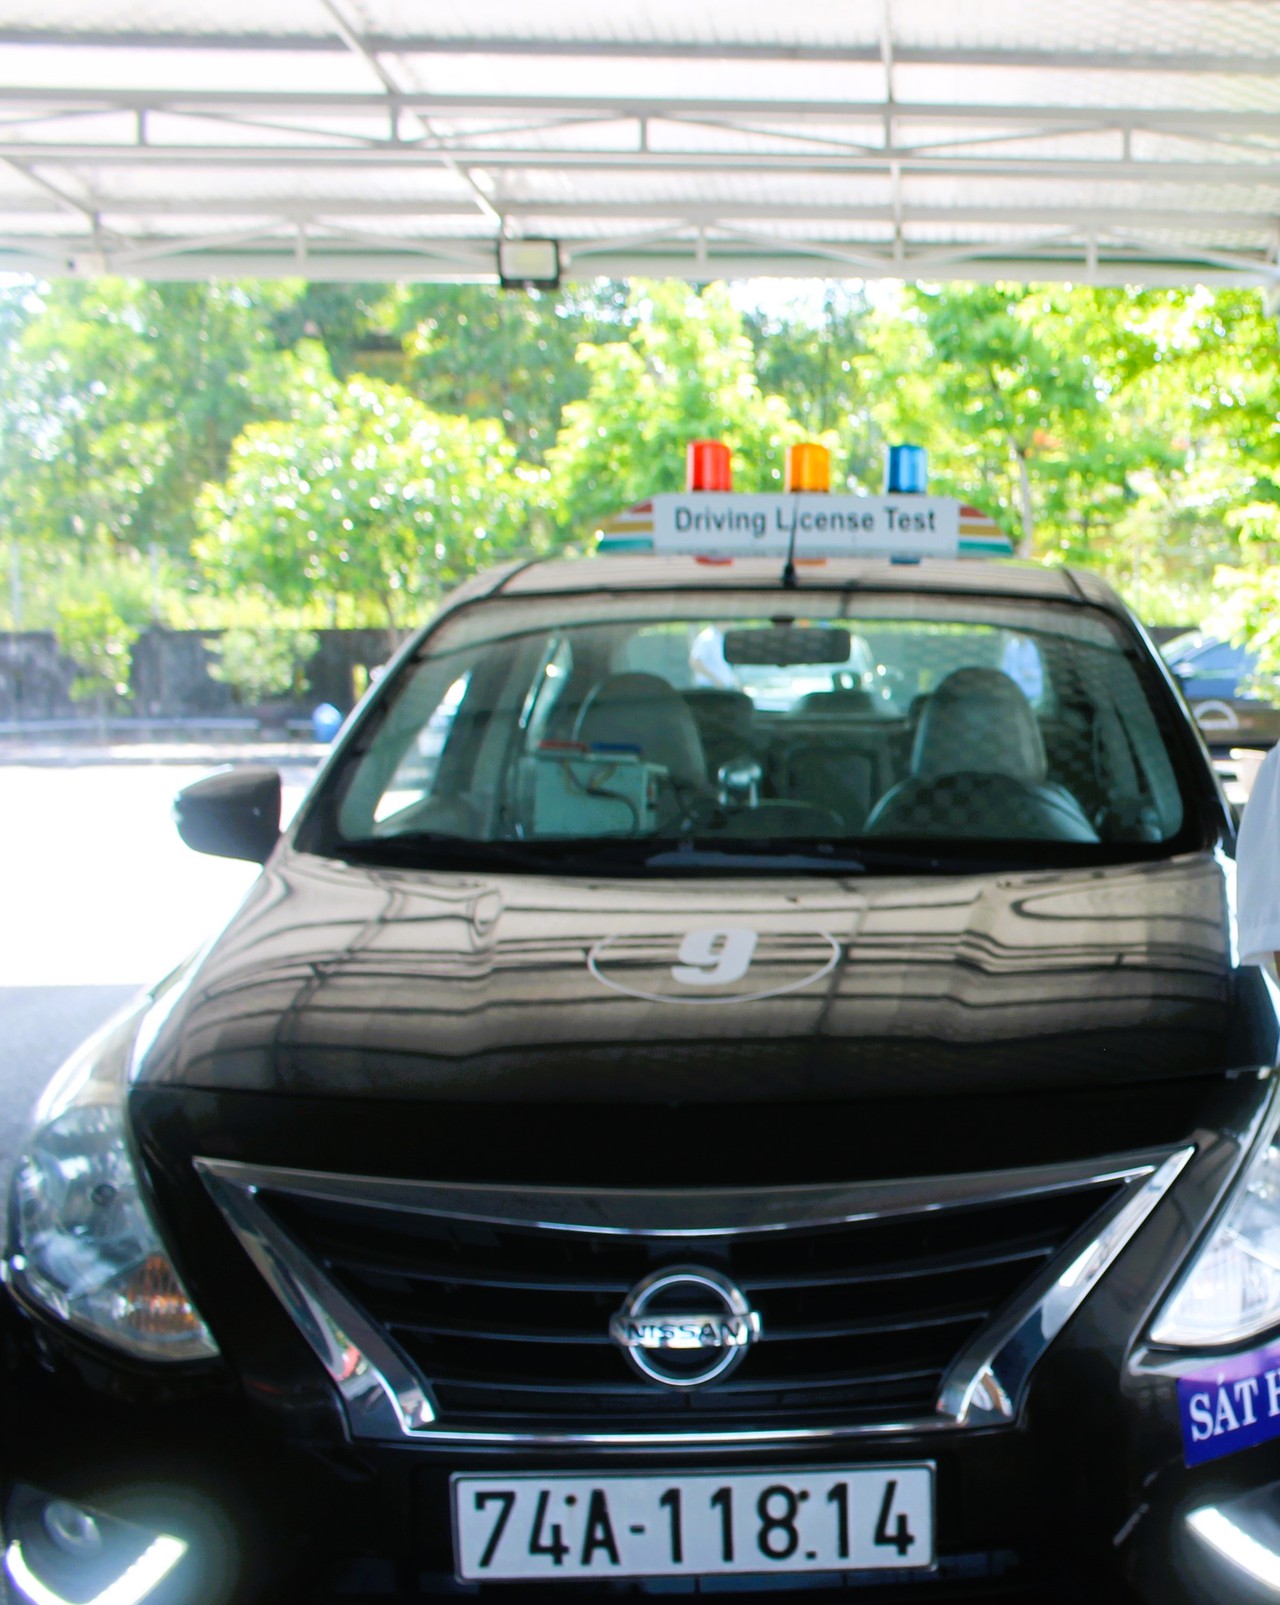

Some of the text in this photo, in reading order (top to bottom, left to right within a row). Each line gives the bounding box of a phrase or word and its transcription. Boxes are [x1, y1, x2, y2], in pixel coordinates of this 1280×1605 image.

[674, 505, 768, 538] Driving
[883, 505, 936, 531] Test
[671, 928, 758, 985] 9
[626, 1321, 749, 1348] NISSAN
[1189, 1372, 1259, 1442] SÁT
[474, 1480, 914, 1567] 74A-118.14
